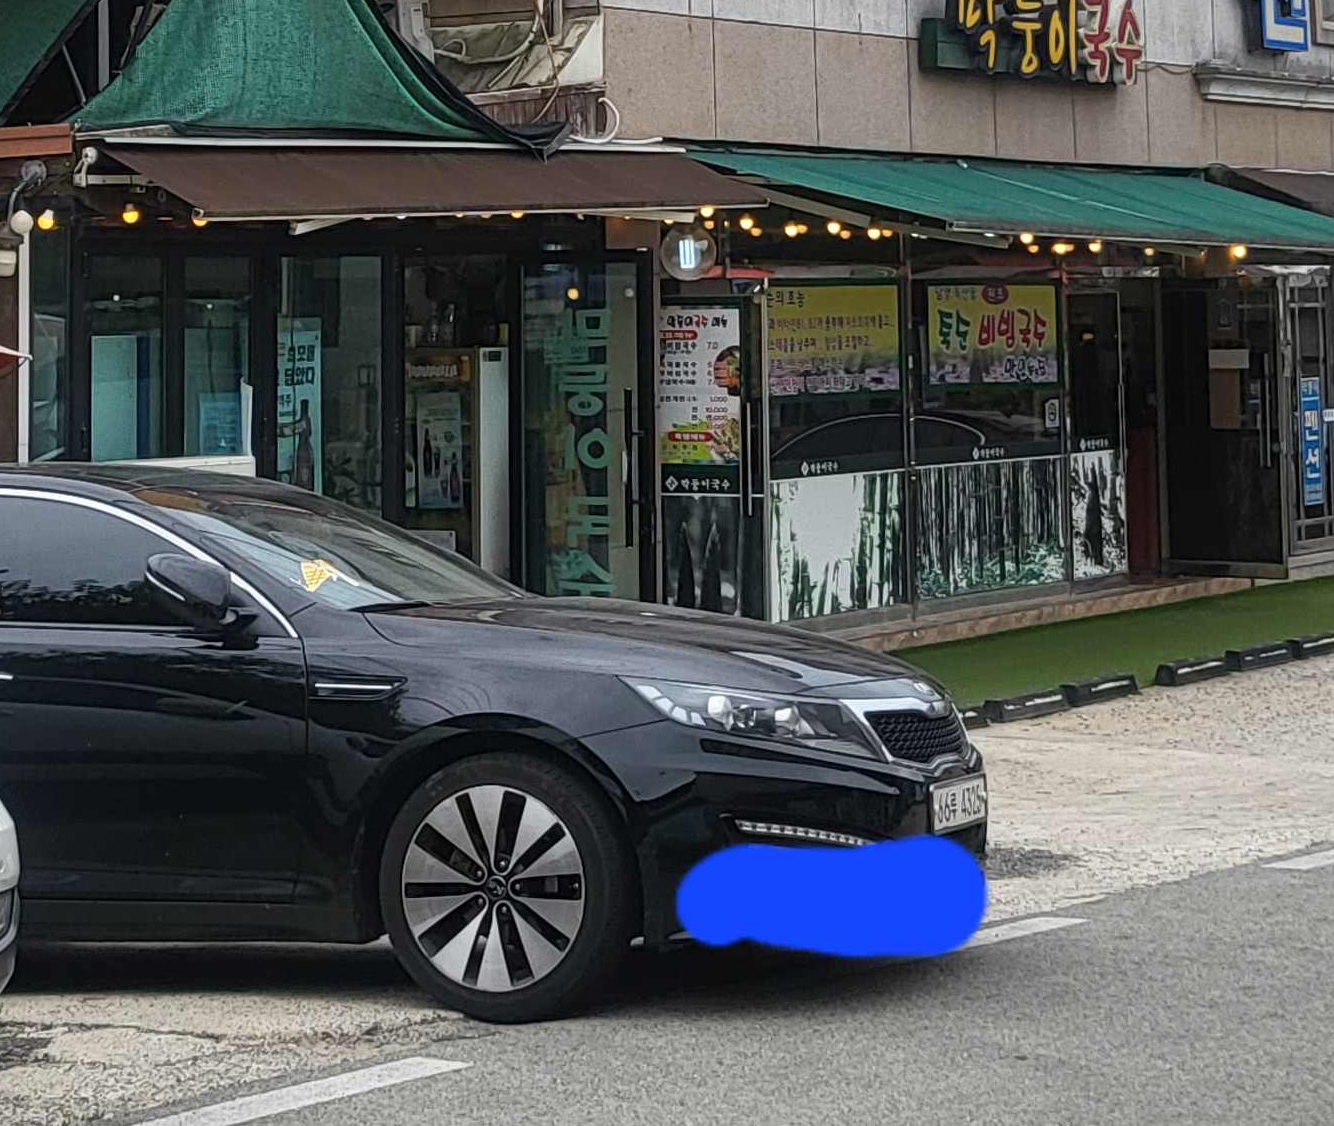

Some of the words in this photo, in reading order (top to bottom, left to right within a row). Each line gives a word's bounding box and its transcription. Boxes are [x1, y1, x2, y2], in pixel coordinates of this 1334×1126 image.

[978, 308, 1047, 349] 비빔국수
[1304, 411, 1320, 479] 펜션
[681, 478, 731, 491] 막둥이국수
